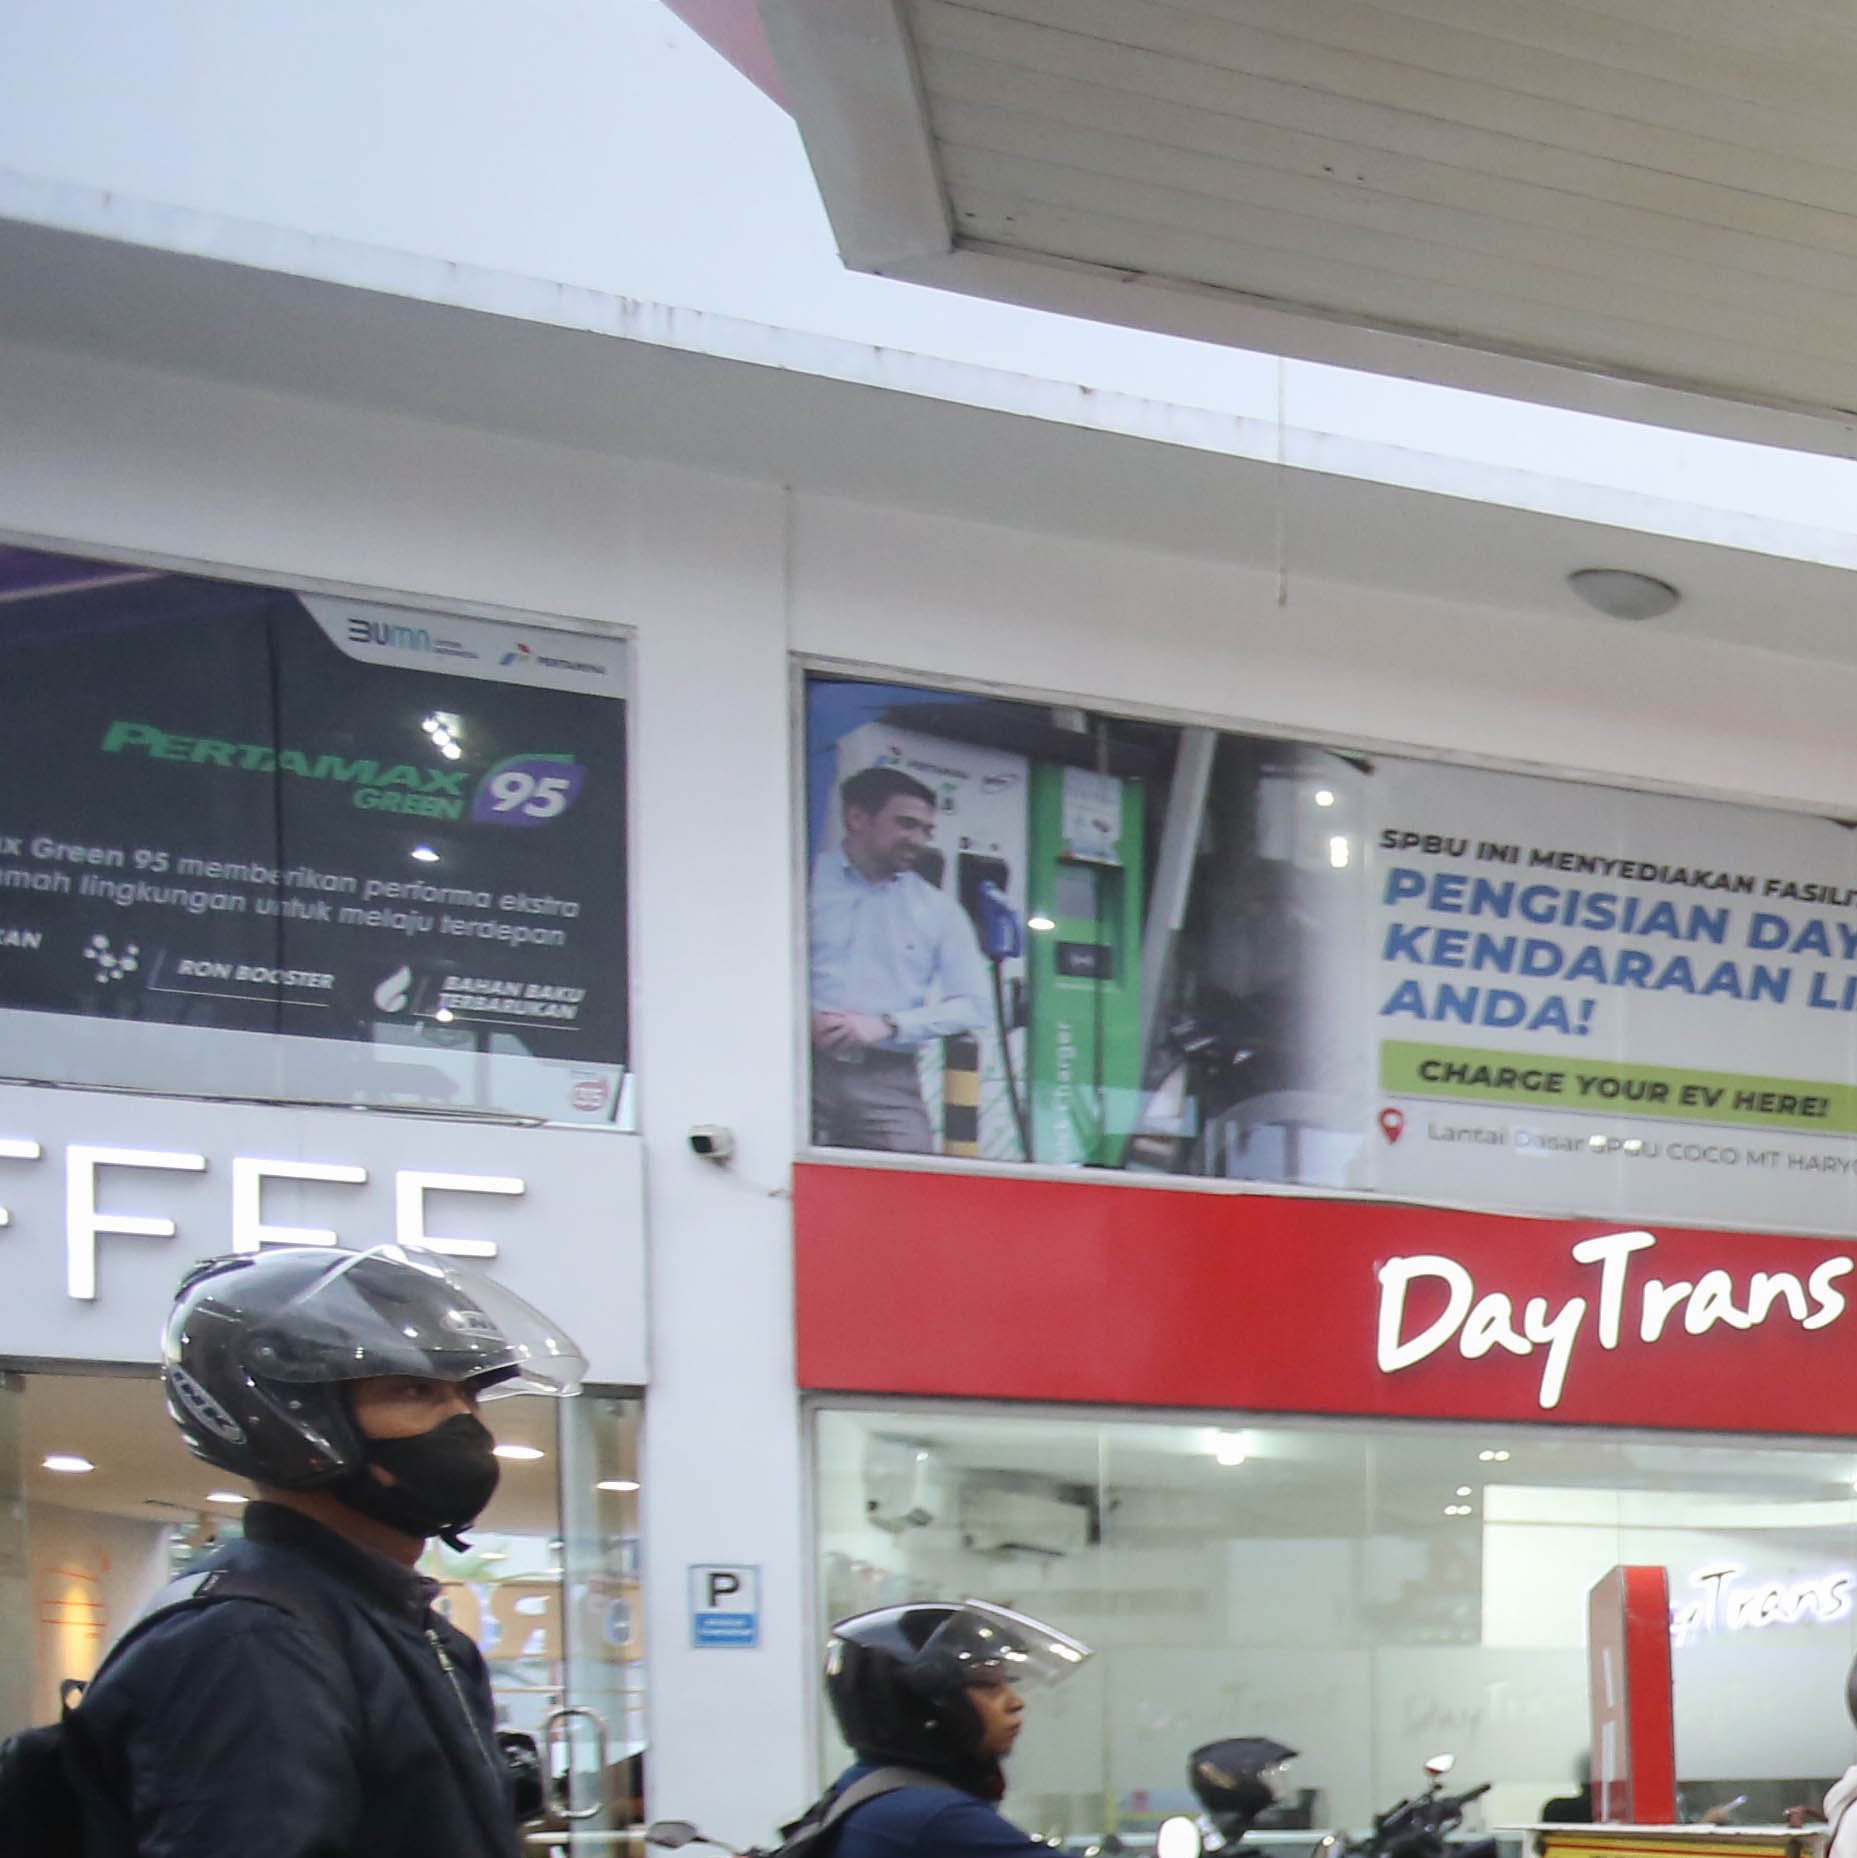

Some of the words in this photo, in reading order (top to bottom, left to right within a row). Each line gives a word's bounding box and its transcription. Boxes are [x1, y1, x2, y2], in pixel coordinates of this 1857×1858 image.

[100, 719, 471, 795] PERTAMAX
[351, 786, 465, 822] GREEN
[489, 770, 573, 819] 95
[30, 836, 126, 868] Green
[133, 848, 171, 873] 95
[176, 856, 357, 894] memberikan
[362, 878, 493, 909] performa
[500, 892, 580, 918] ekstra
[1379, 828, 1468, 858] SPBU
[1476, 840, 1520, 865] INI
[1528, 847, 1755, 895] MENYEDIAKAN
[79, 873, 247, 915] lingkungan
[254, 896, 333, 923] untuk
[337, 906, 434, 937] melaju
[438, 914, 566, 948] terdepan
[1382, 866, 1732, 945] PENGISIAN
[1382, 922, 1792, 1004] KENDARAAN
[1379, 978, 1597, 1037] ANDA!
[1417, 1059, 1566, 1094] CHARGE
[1576, 1074, 1669, 1104] YOUR
[1677, 1085, 1725, 1108] EV
[1732, 1090, 1832, 1118] HERE!
[1746, 1150, 1780, 1168] MT
[1376, 1230, 1856, 1408] DayTrans
[708, 1572, 741, 1608] P
